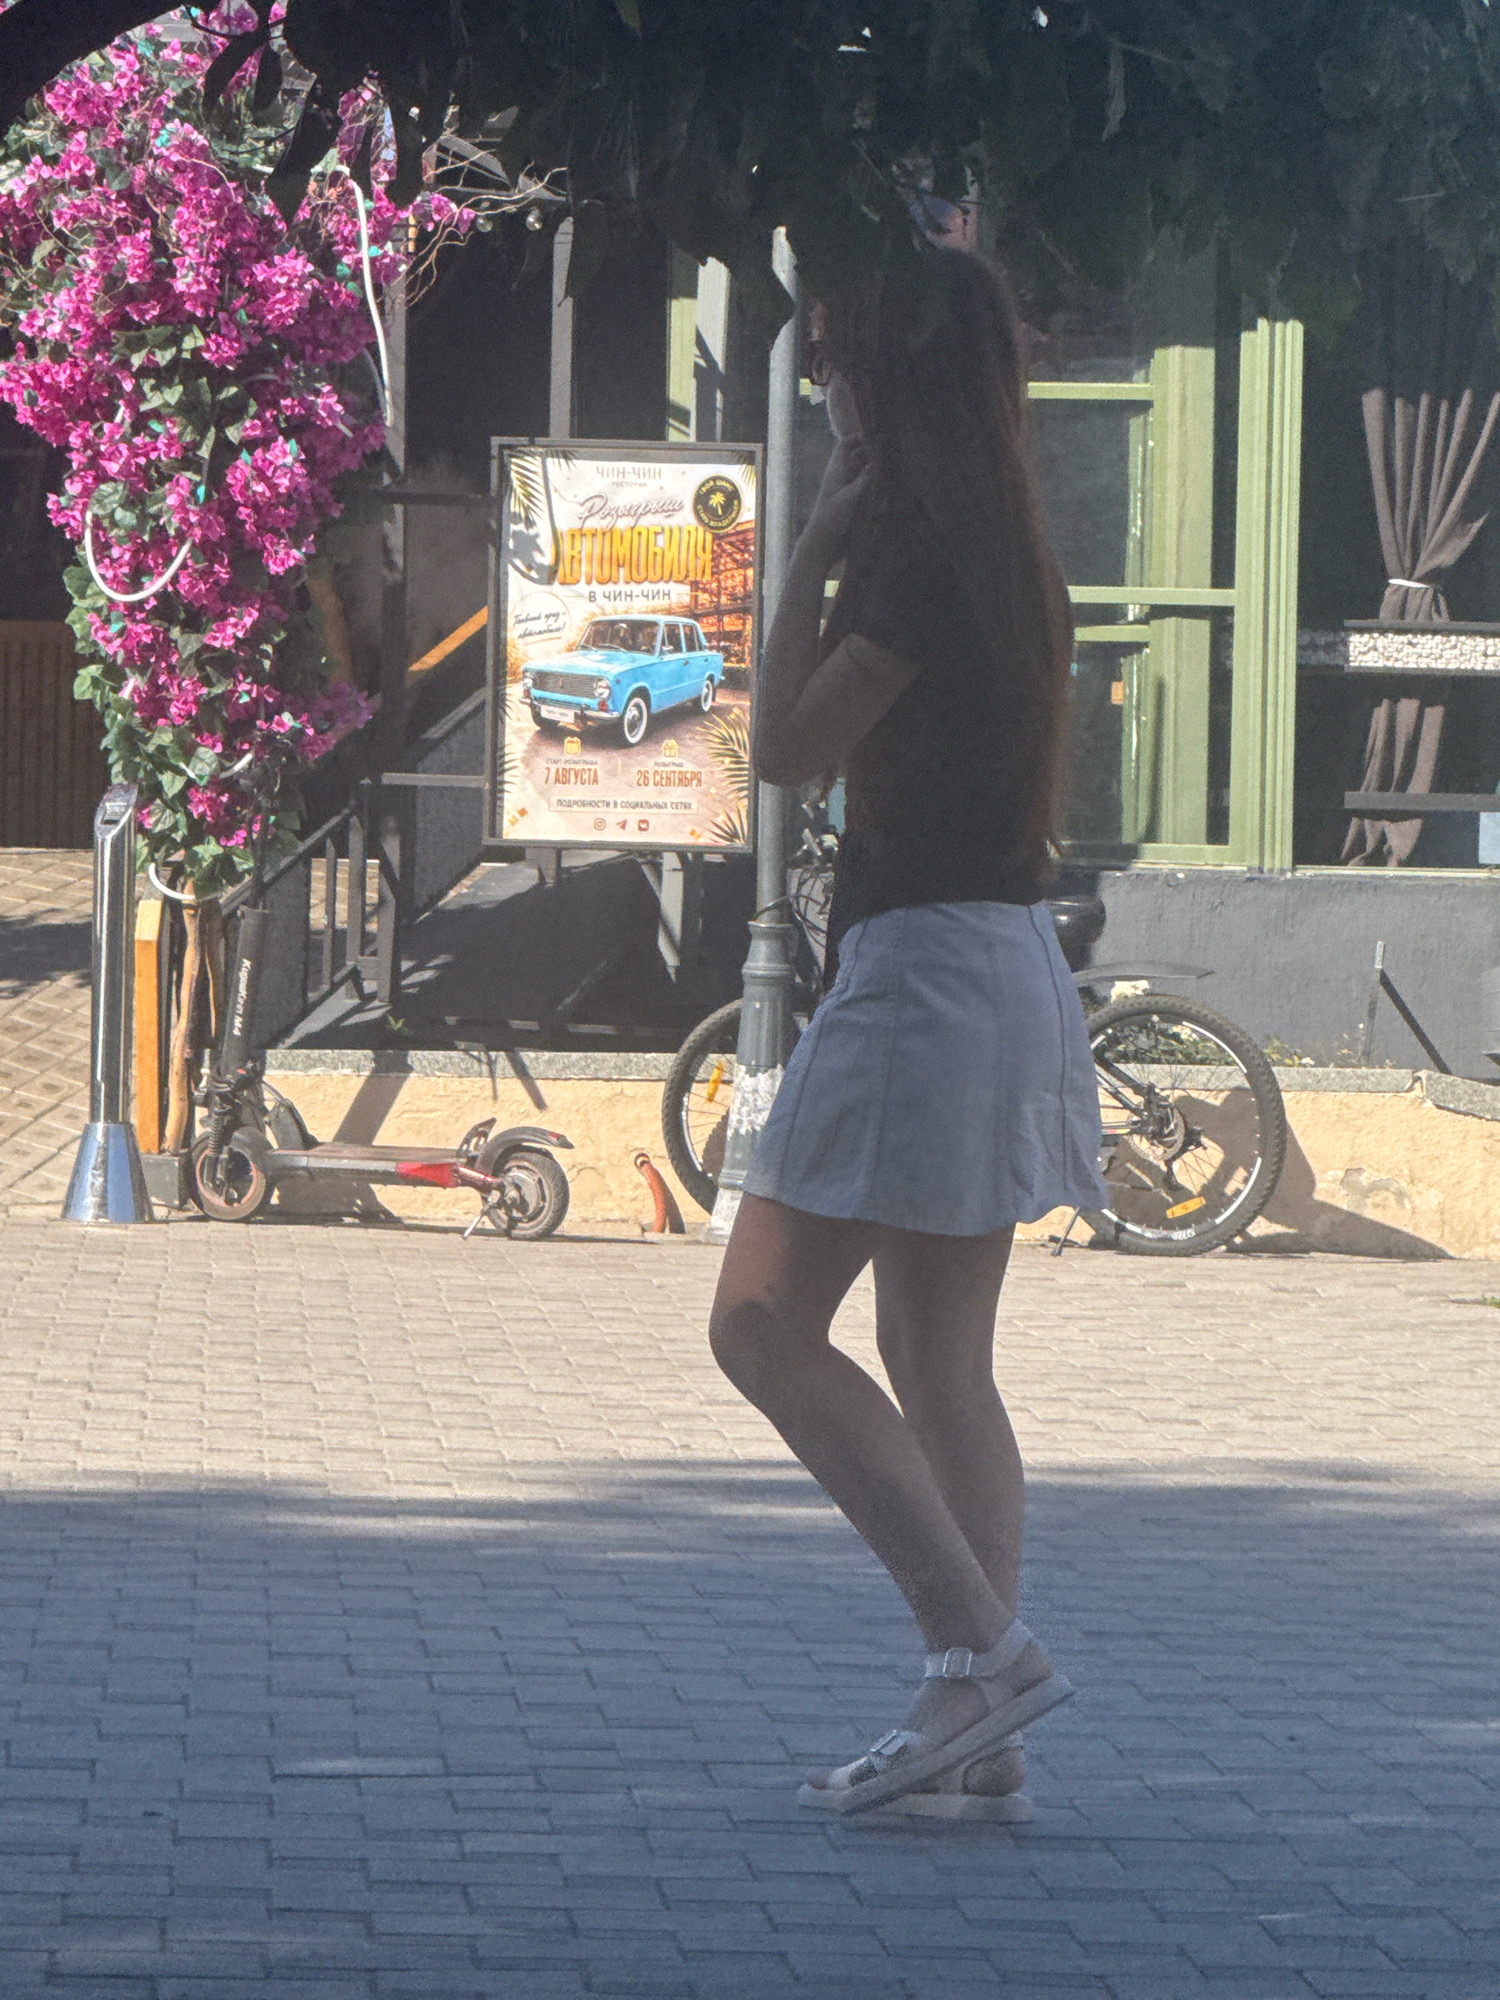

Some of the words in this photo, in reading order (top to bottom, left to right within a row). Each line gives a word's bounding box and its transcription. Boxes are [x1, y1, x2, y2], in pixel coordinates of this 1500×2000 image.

[596, 466, 662, 480] ЧИН-ЧИН
[578, 492, 685, 530] Розыгрыш
[588, 590, 597, 603] В
[602, 588, 672, 603] ЧИН-ЧИН
[545, 766, 551, 785] 7
[554, 767, 599, 786] АВГУСТА
[636, 769, 650, 787] 26
[653, 770, 703, 788] СЕНТЯБРЯ
[556, 798, 611, 809] ПОДРОБНОСТИ
[613, 799, 619, 809] В
[620, 800, 669, 811] СОЦИАЛЬНЫХ
[671, 800, 692, 811] СЕТЯХ
